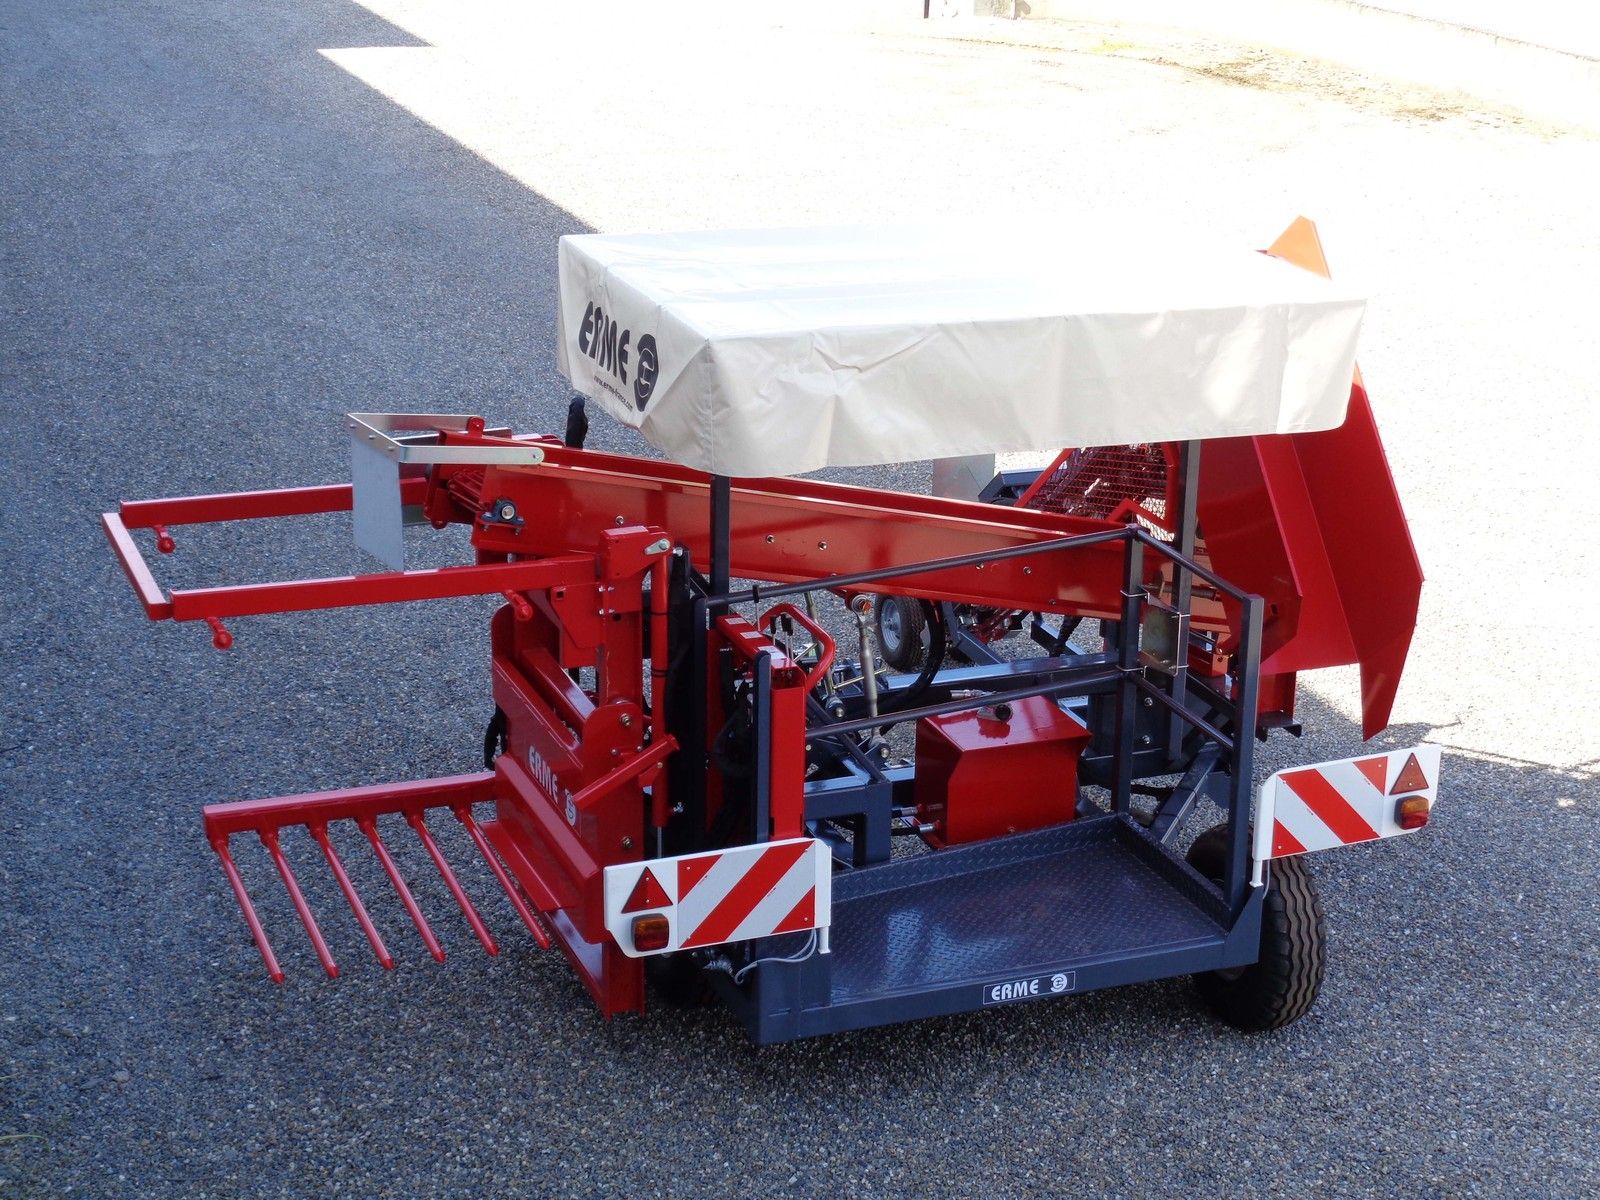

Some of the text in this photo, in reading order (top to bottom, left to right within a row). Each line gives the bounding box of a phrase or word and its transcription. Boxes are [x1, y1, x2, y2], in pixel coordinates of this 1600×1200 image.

[579, 301, 630, 385] ERME
[529, 746, 558, 803] ERME
[991, 979, 1039, 1001] ERME
